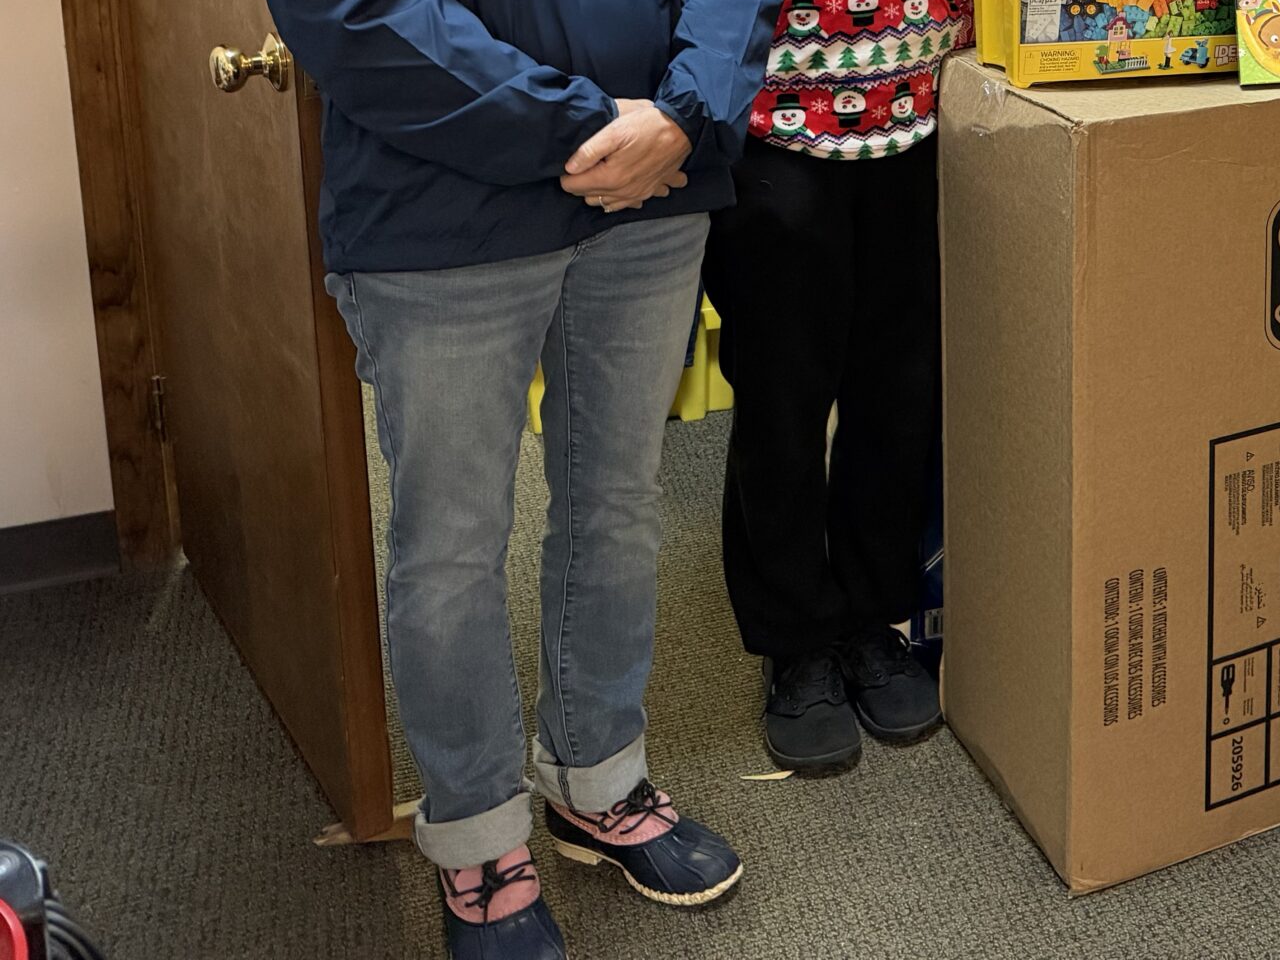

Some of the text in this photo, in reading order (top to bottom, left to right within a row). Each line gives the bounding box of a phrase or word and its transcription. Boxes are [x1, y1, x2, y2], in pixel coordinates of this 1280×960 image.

[1214, 44, 1238, 58] IDE
[1105, 578, 1119, 622] CONTENIDO:
[1129, 569, 1144, 603] CONTENU
[1152, 568, 1168, 607] CONTENTS:
[1104, 628, 1119, 654] COCINA
[1128, 614, 1143, 643] CUISINE
[1152, 612, 1167, 643] KITCHEN
[1104, 655, 1119, 670] CON
[1128, 643, 1143, 660] AVEC
[1152, 642, 1166, 662] WITH
[1104, 671, 1118, 685] LOS
[1128, 662, 1142, 675] DES
[1128, 675, 1142, 720] ACCESSOIRES
[1152, 664, 1166, 708] ACCESSORIES
[1104, 684, 1118, 727] ACCESORIOS
[1231, 736, 1243, 792] 205926
